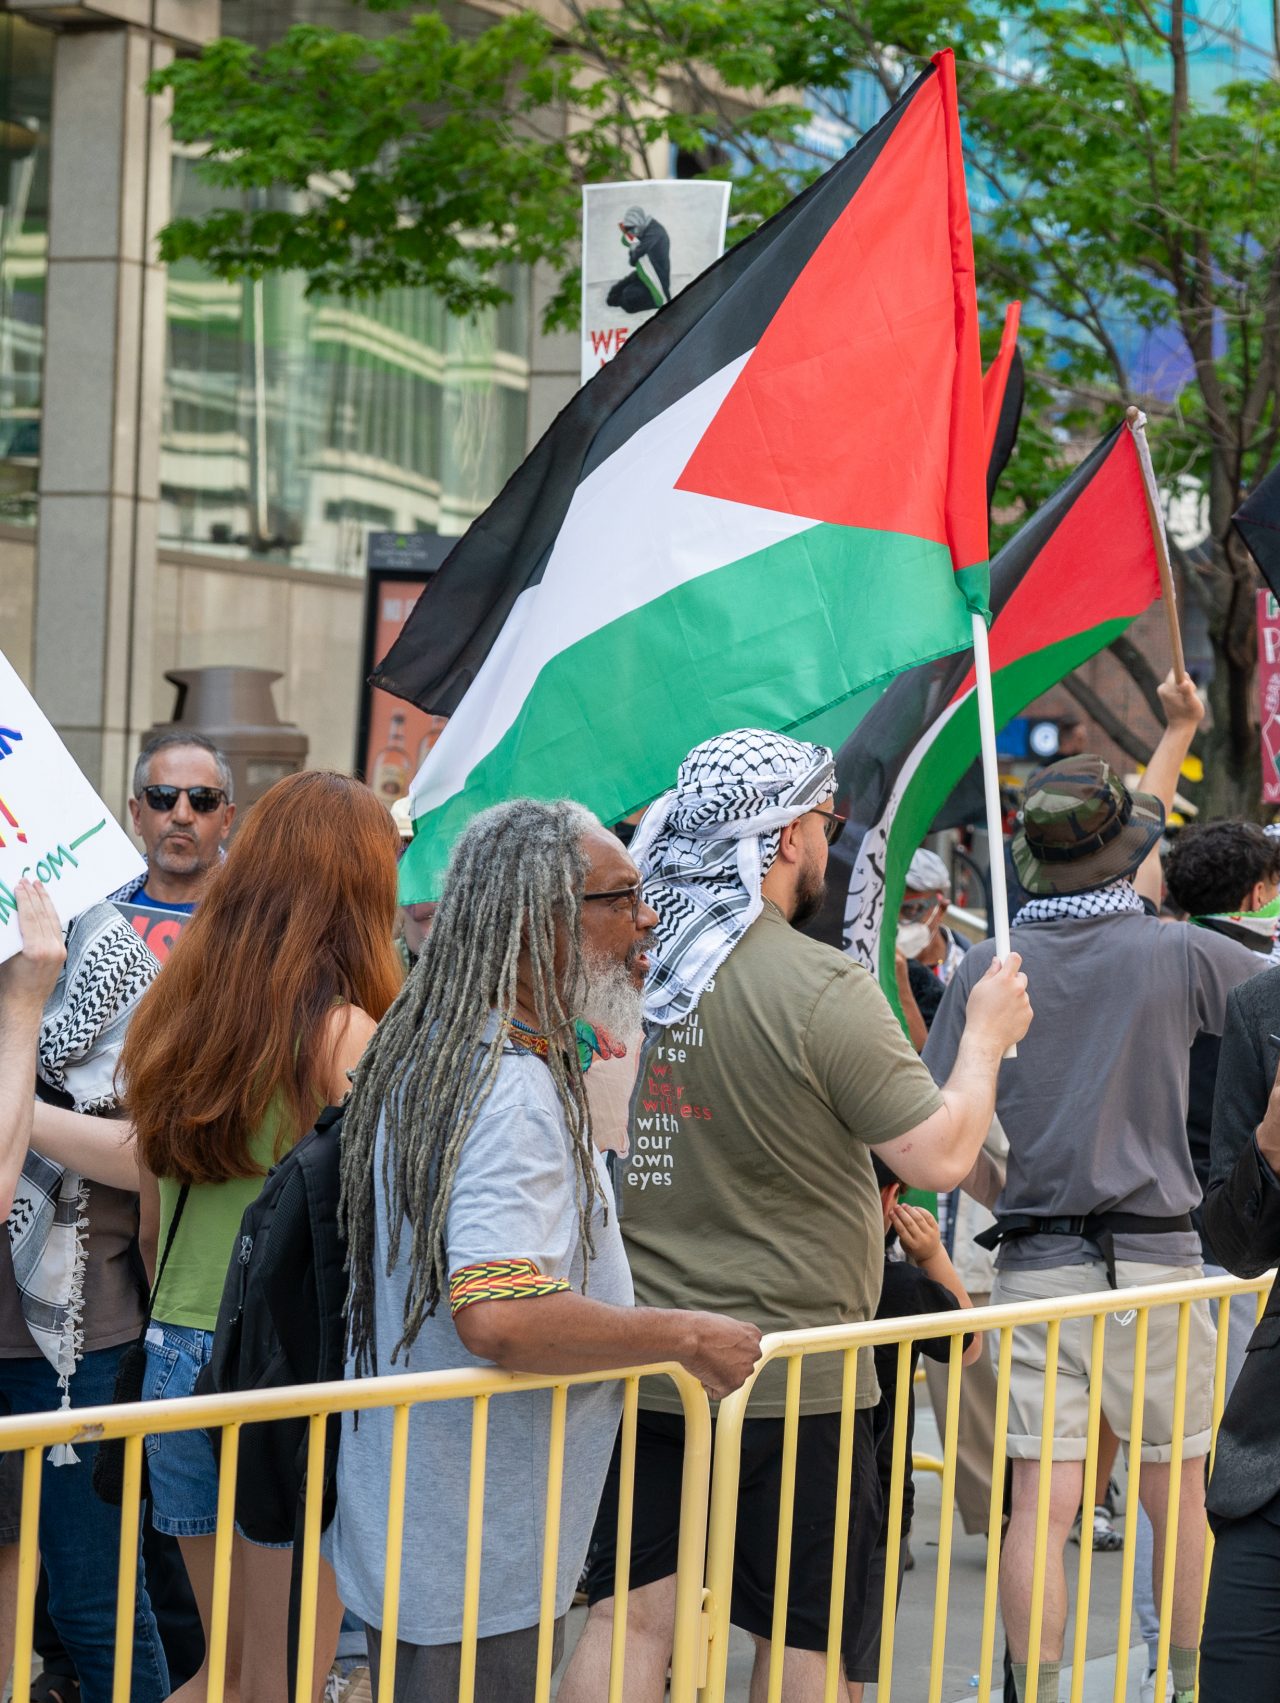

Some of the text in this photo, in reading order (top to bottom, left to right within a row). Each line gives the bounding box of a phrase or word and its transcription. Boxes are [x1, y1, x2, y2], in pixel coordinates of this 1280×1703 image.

[666, 1013, 699, 1029] ou
[671, 1026, 704, 1047] will
[643, 1097, 713, 1120] witess
[637, 1113, 679, 1133] with
[637, 1135, 672, 1150] our
[631, 1153, 674, 1168] own
[627, 1171, 673, 1190] eyes
